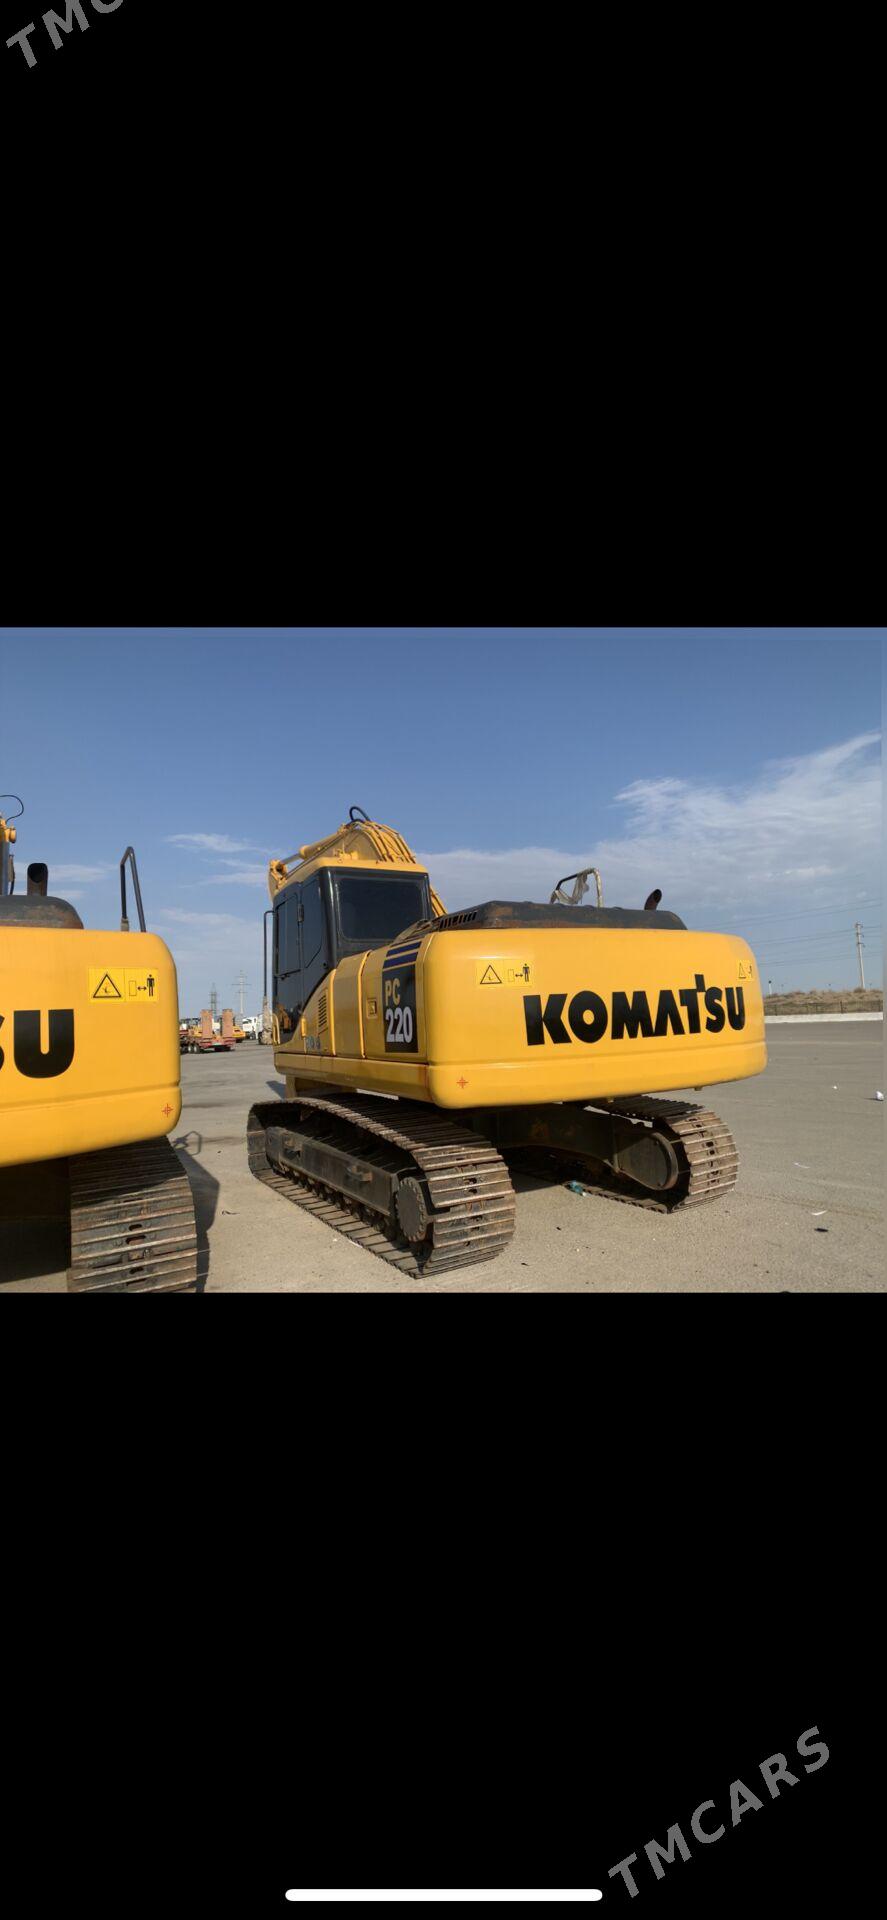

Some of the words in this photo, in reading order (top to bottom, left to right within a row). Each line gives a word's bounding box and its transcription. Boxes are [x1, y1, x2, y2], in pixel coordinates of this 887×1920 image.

[384, 978, 400, 1006] PC
[523, 974, 746, 1046] KOMATSU
[0, 1009, 75, 1078] U
[385, 1006, 413, 1043] 220
